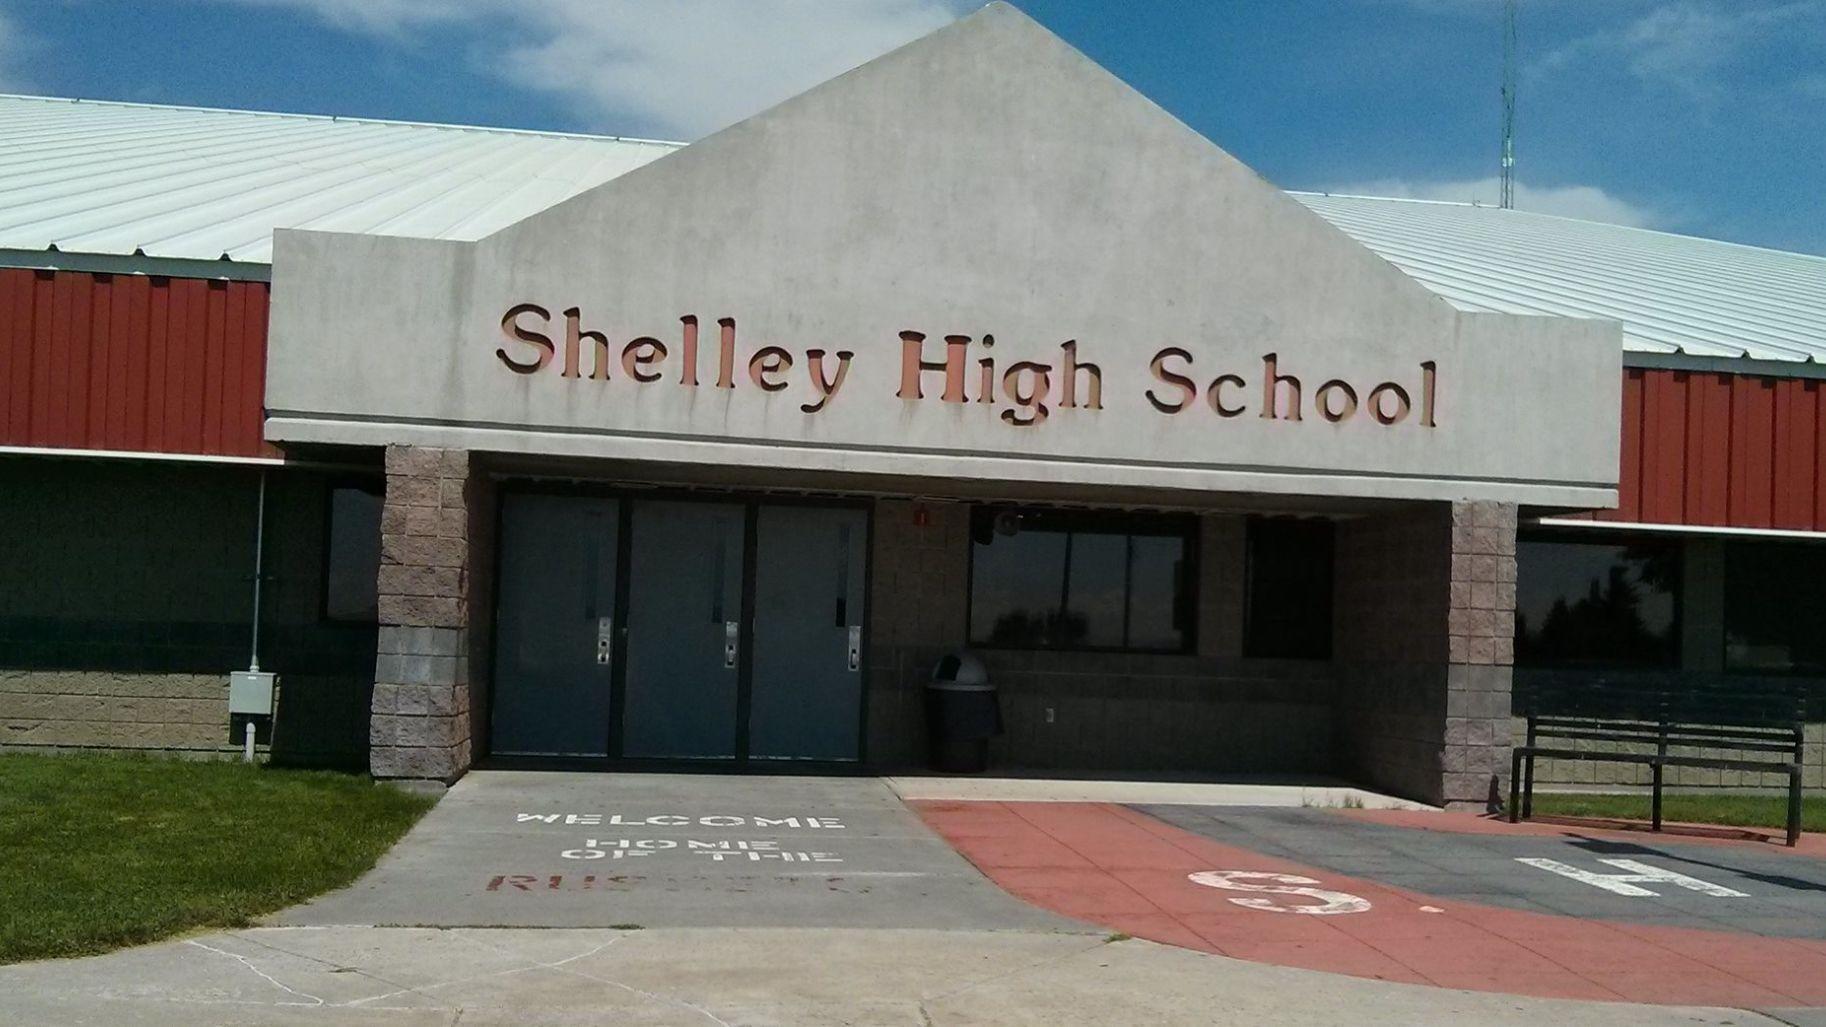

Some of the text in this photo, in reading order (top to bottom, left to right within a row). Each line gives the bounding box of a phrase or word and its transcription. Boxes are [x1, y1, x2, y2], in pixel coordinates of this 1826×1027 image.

[496, 303, 1438, 428] Shelley High School
[517, 813, 846, 829] WELCOME
[586, 839, 780, 851] HOME
[561, 849, 844, 862] OF THE
